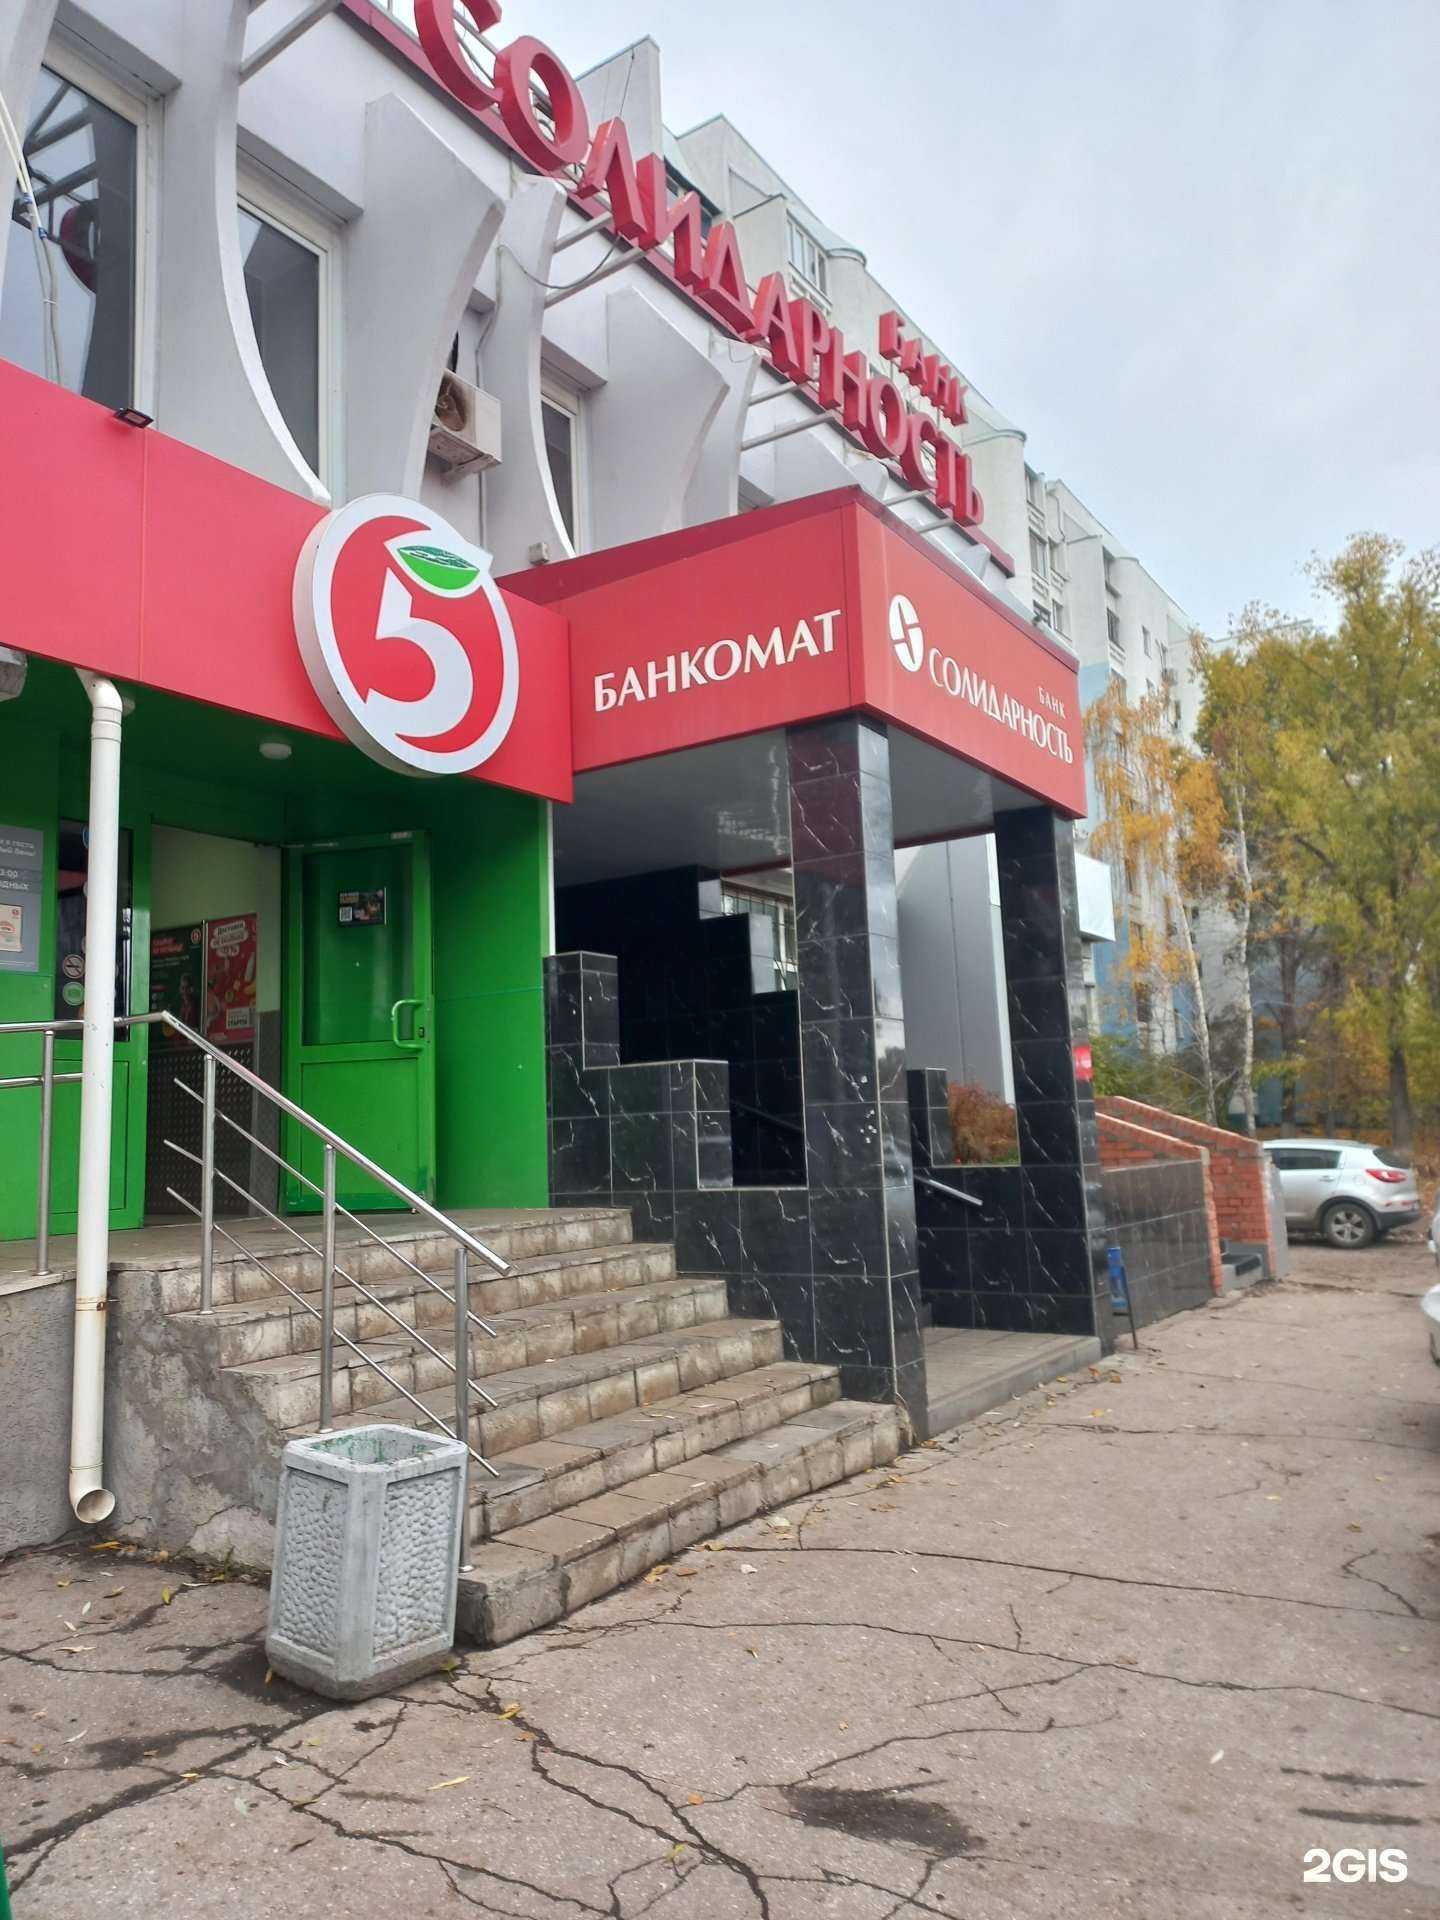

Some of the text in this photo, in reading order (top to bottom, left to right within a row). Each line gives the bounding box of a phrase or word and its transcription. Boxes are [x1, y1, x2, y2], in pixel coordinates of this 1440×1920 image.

[413, 0, 984, 527] СОЛИДАРНОСТЬ
[879, 311, 969, 426] БАНК
[594, 609, 842, 712] БАНКОМАТ
[929, 647, 1073, 764] СОЛИДАРНОСТЬ
[1037, 686, 1066, 720] БАНК
